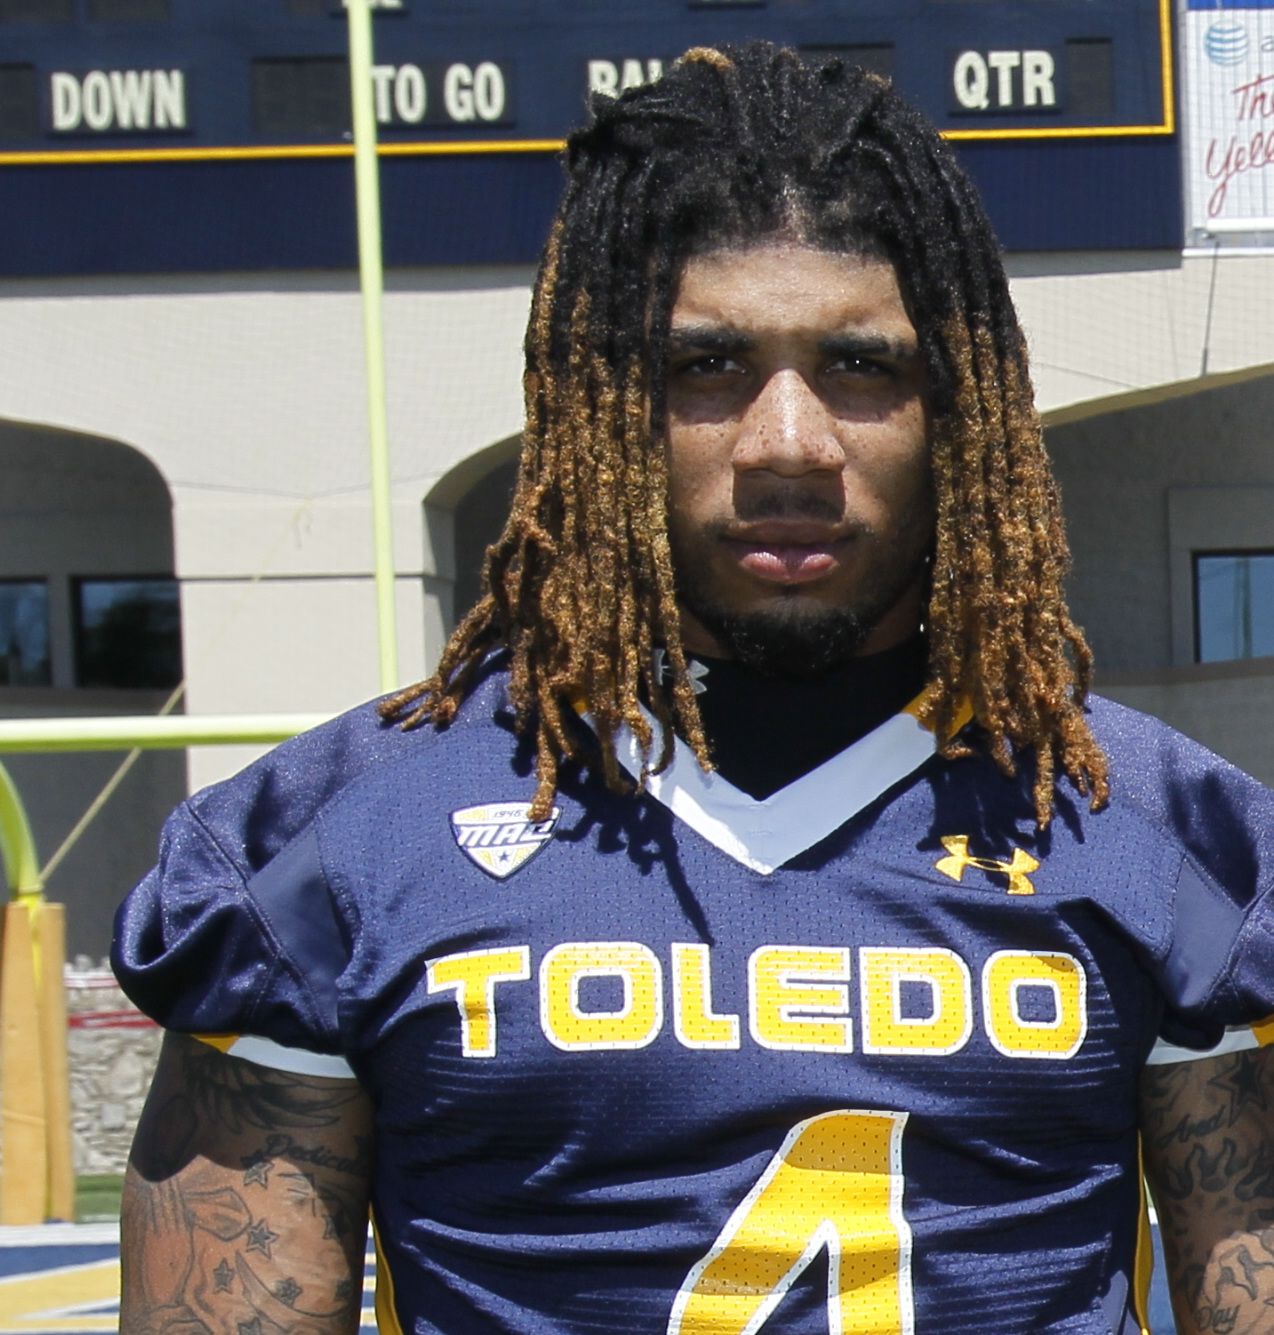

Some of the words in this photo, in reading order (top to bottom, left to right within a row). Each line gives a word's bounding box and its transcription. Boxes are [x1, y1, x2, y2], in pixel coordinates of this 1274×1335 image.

[51, 69, 186, 130] DOWN
[371, 64, 426, 123] TO
[444, 61, 505, 122] GO
[953, 50, 1055, 109] QTR
[458, 820, 554, 847] MAC
[425, 942, 1087, 1059] TOLEDO
